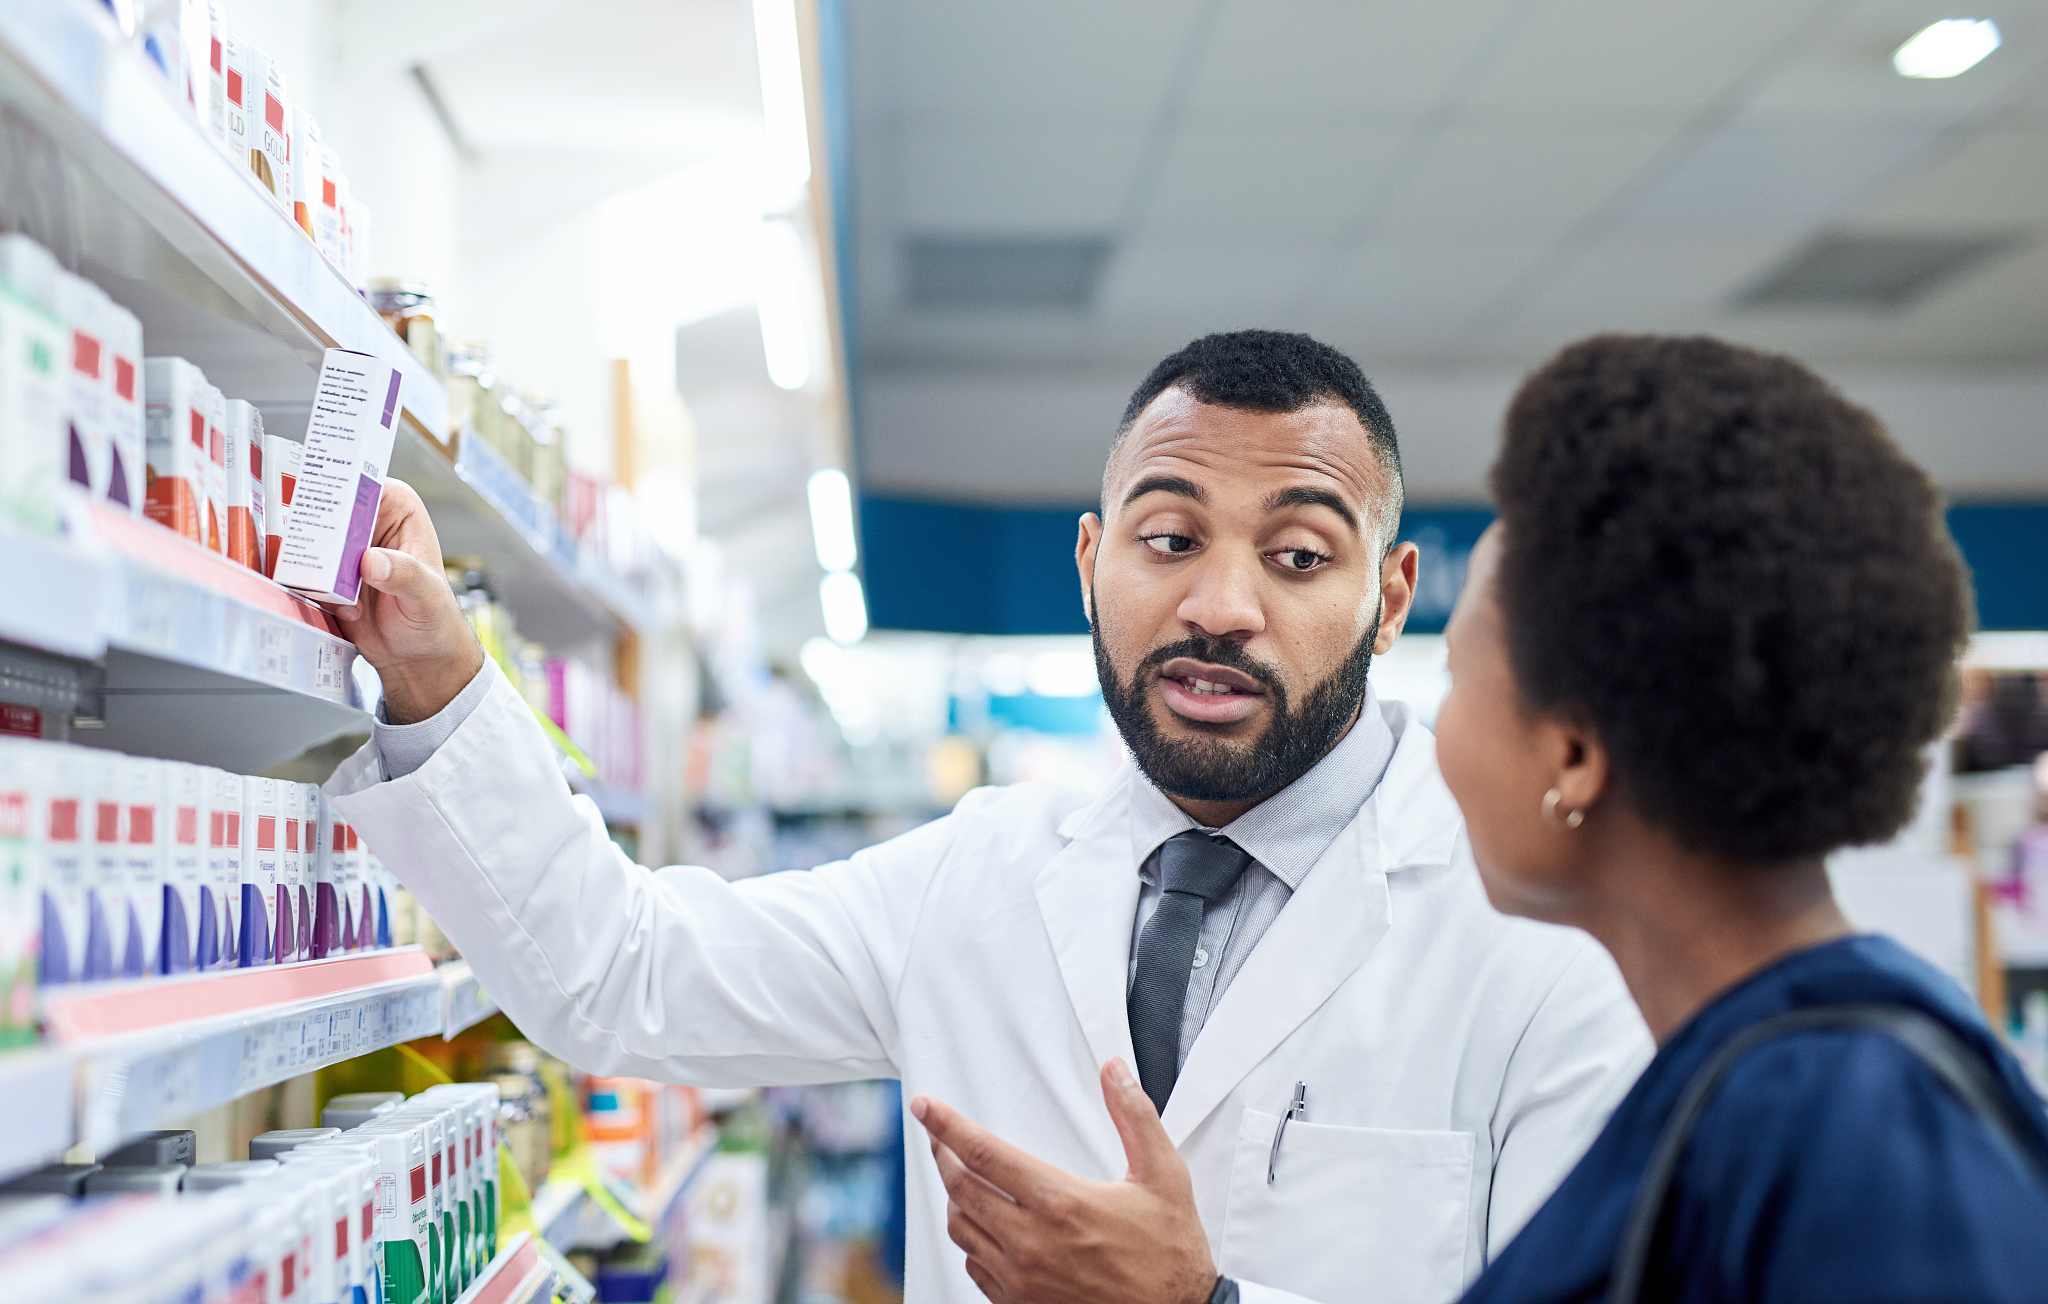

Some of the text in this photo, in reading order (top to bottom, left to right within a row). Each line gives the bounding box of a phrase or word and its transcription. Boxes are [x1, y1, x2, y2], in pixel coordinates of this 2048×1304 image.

[264, 130, 285, 166] GOLD
[259, 859, 276, 871] Flaxseed
[411, 1207, 428, 1224] Odourless
[418, 1220, 428, 1235] Garlic
